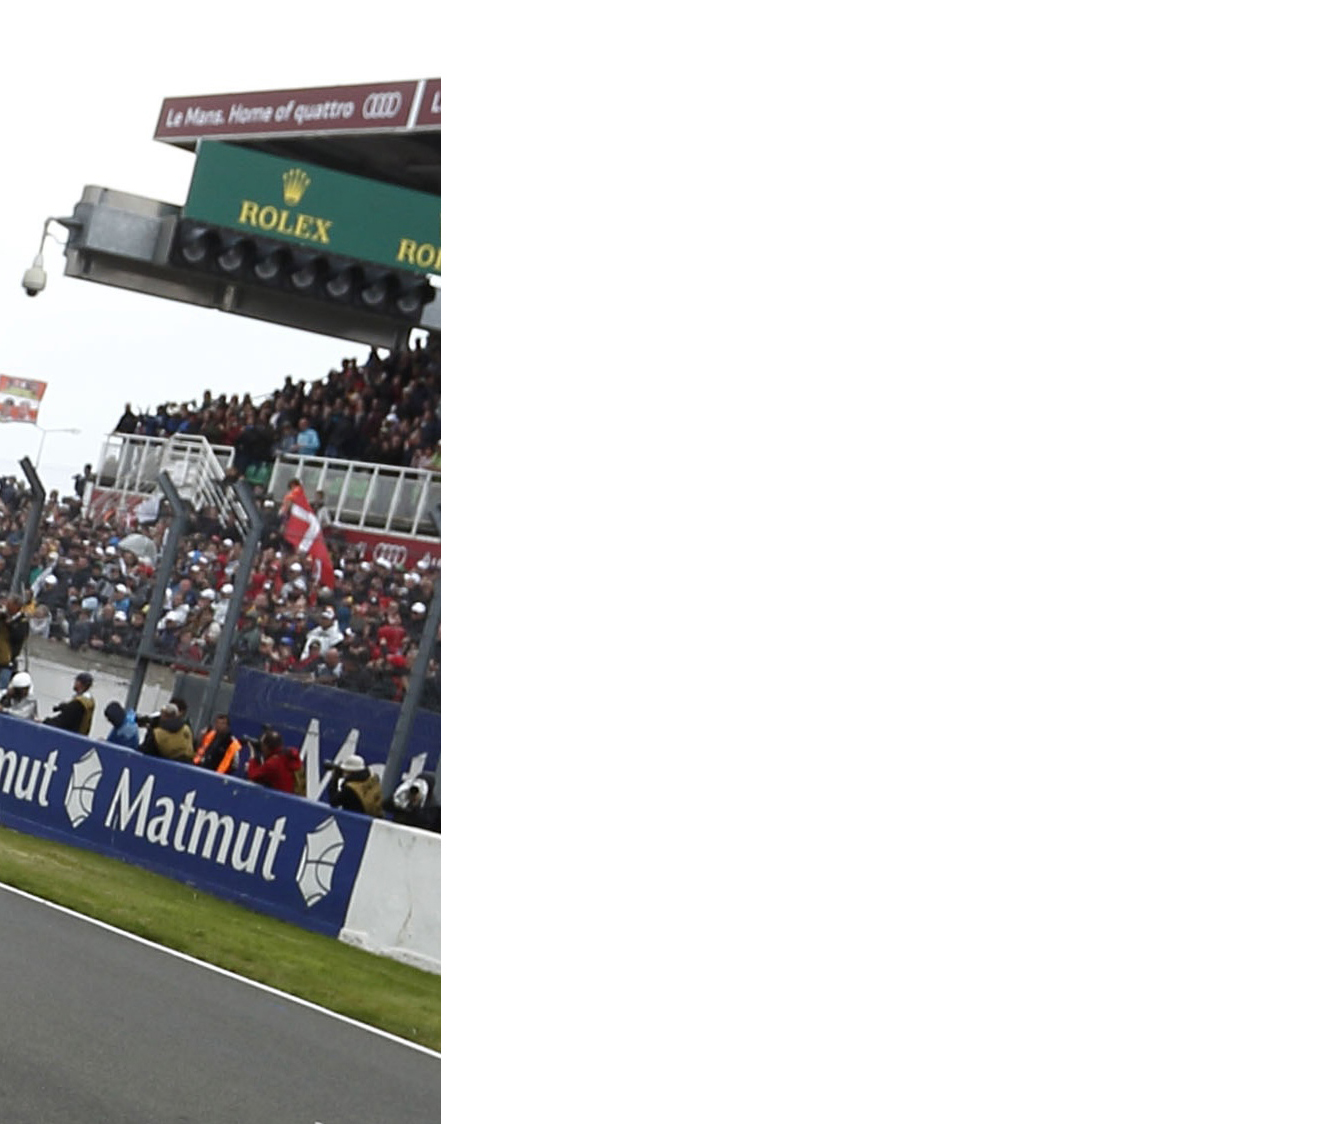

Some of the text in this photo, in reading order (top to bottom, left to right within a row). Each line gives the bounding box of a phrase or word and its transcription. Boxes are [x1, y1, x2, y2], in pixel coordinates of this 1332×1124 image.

[166, 100, 355, 128] Le Mans. Home of quattro
[238, 199, 334, 244] ROLEX
[104, 767, 287, 881] Matmut
